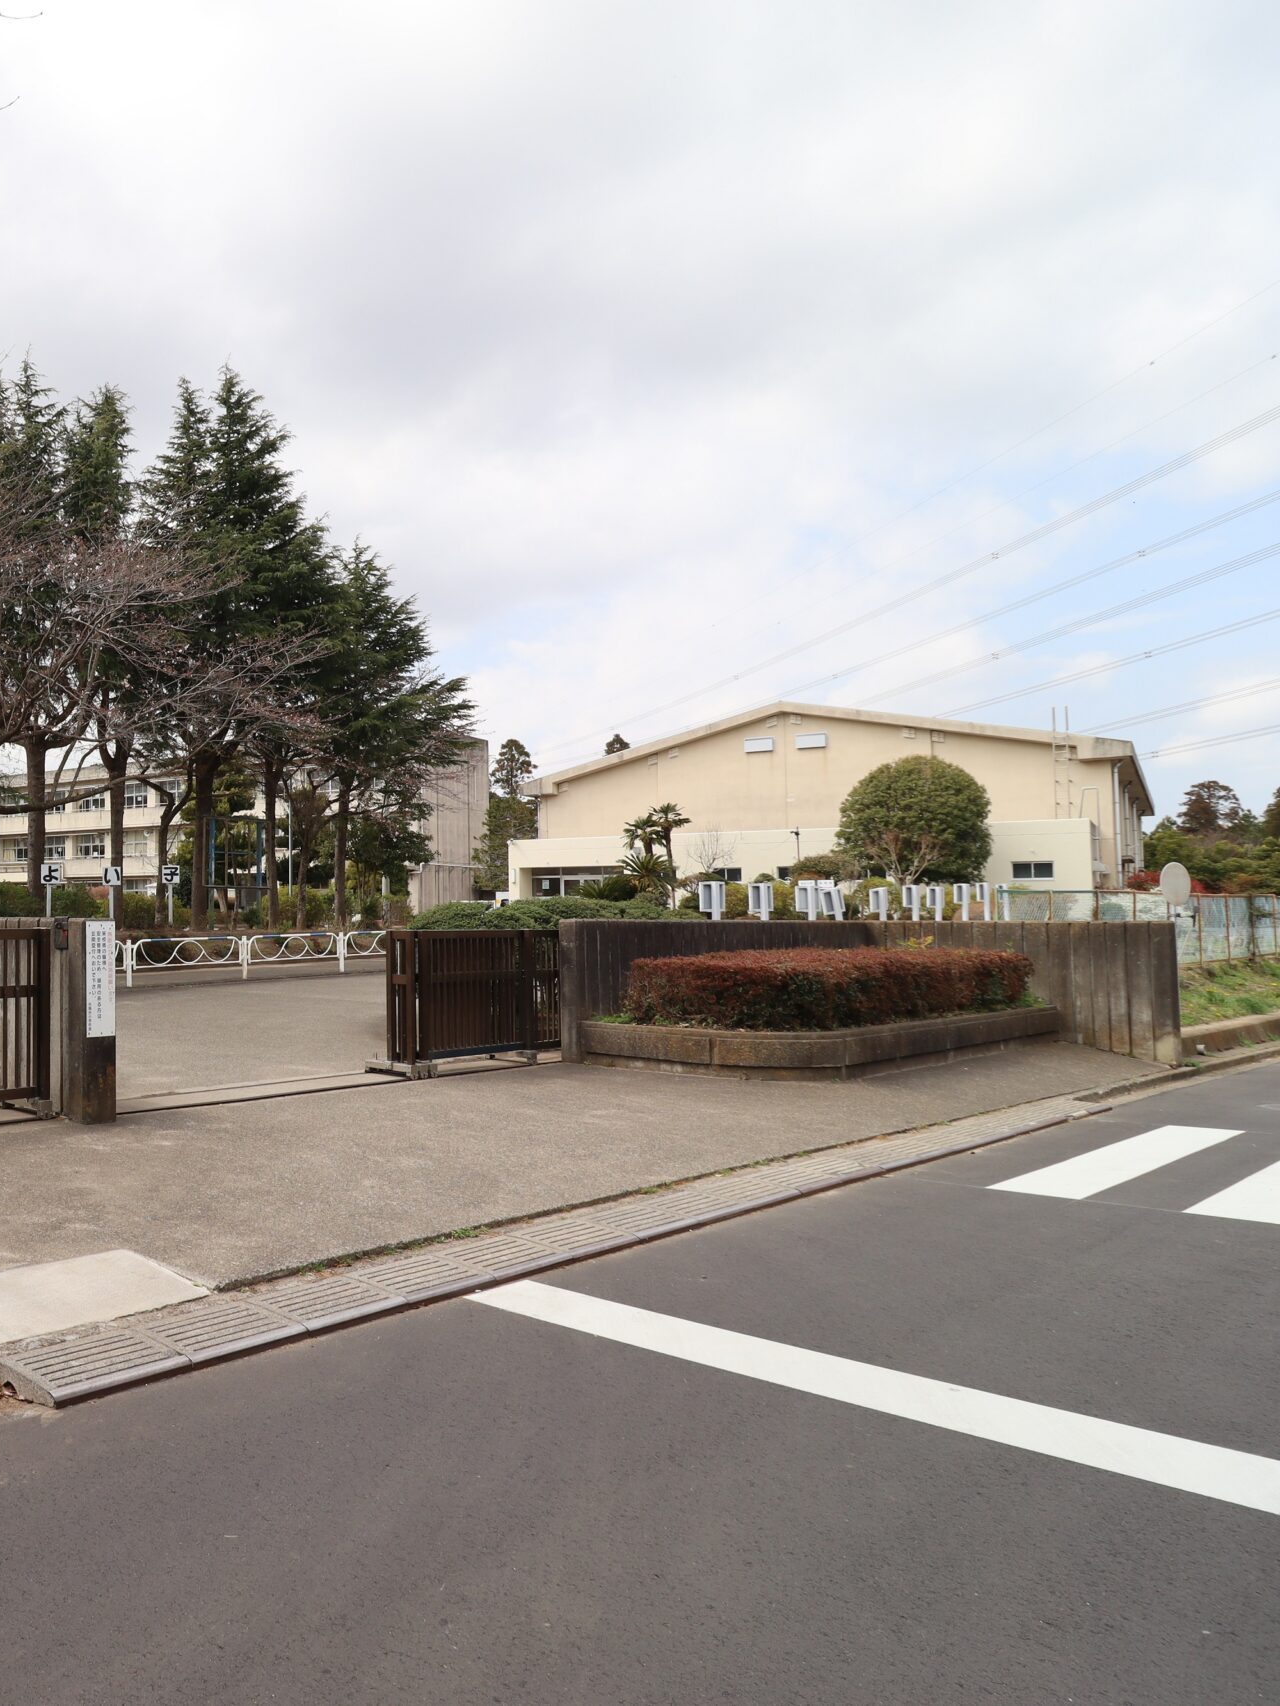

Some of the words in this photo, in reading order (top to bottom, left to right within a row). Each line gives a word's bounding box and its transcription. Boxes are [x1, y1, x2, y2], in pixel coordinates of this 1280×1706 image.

[42, 865, 59, 882] よ
[104, 867, 120, 884] い
[163, 866, 180, 882] 子
